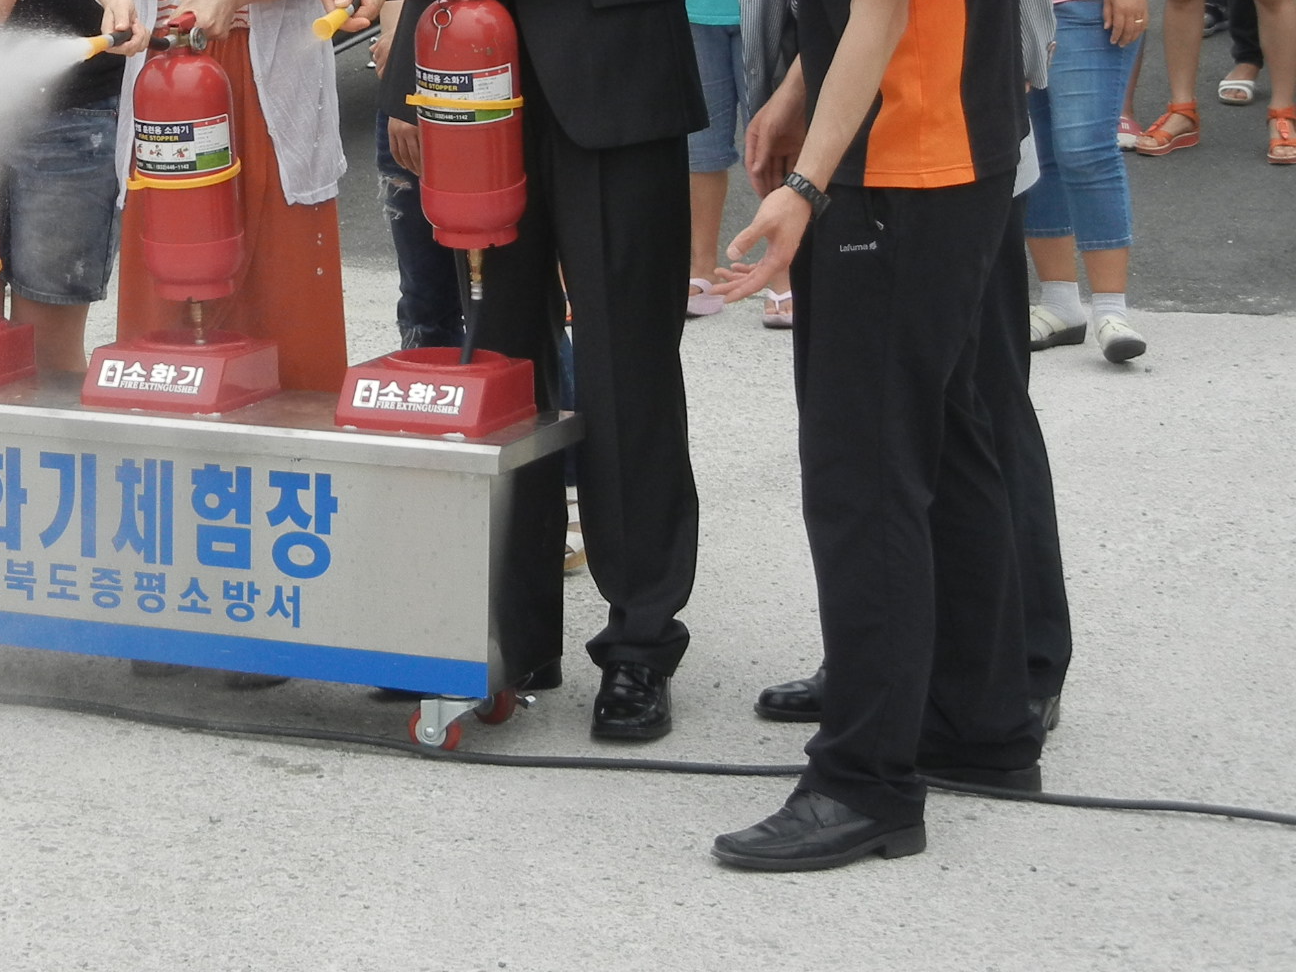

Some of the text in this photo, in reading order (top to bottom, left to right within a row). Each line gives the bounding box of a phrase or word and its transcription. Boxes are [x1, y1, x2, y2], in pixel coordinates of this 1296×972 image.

[443, 75, 469, 85] 소화기
[164, 125, 190, 135] 소화기
[122, 361, 204, 387] 소화기
[120, 380, 199, 395] FIRE EXTINGUISHER
[378, 381, 465, 407] 소화기
[375, 401, 460, 415] FIRE EXTINGUISHER
